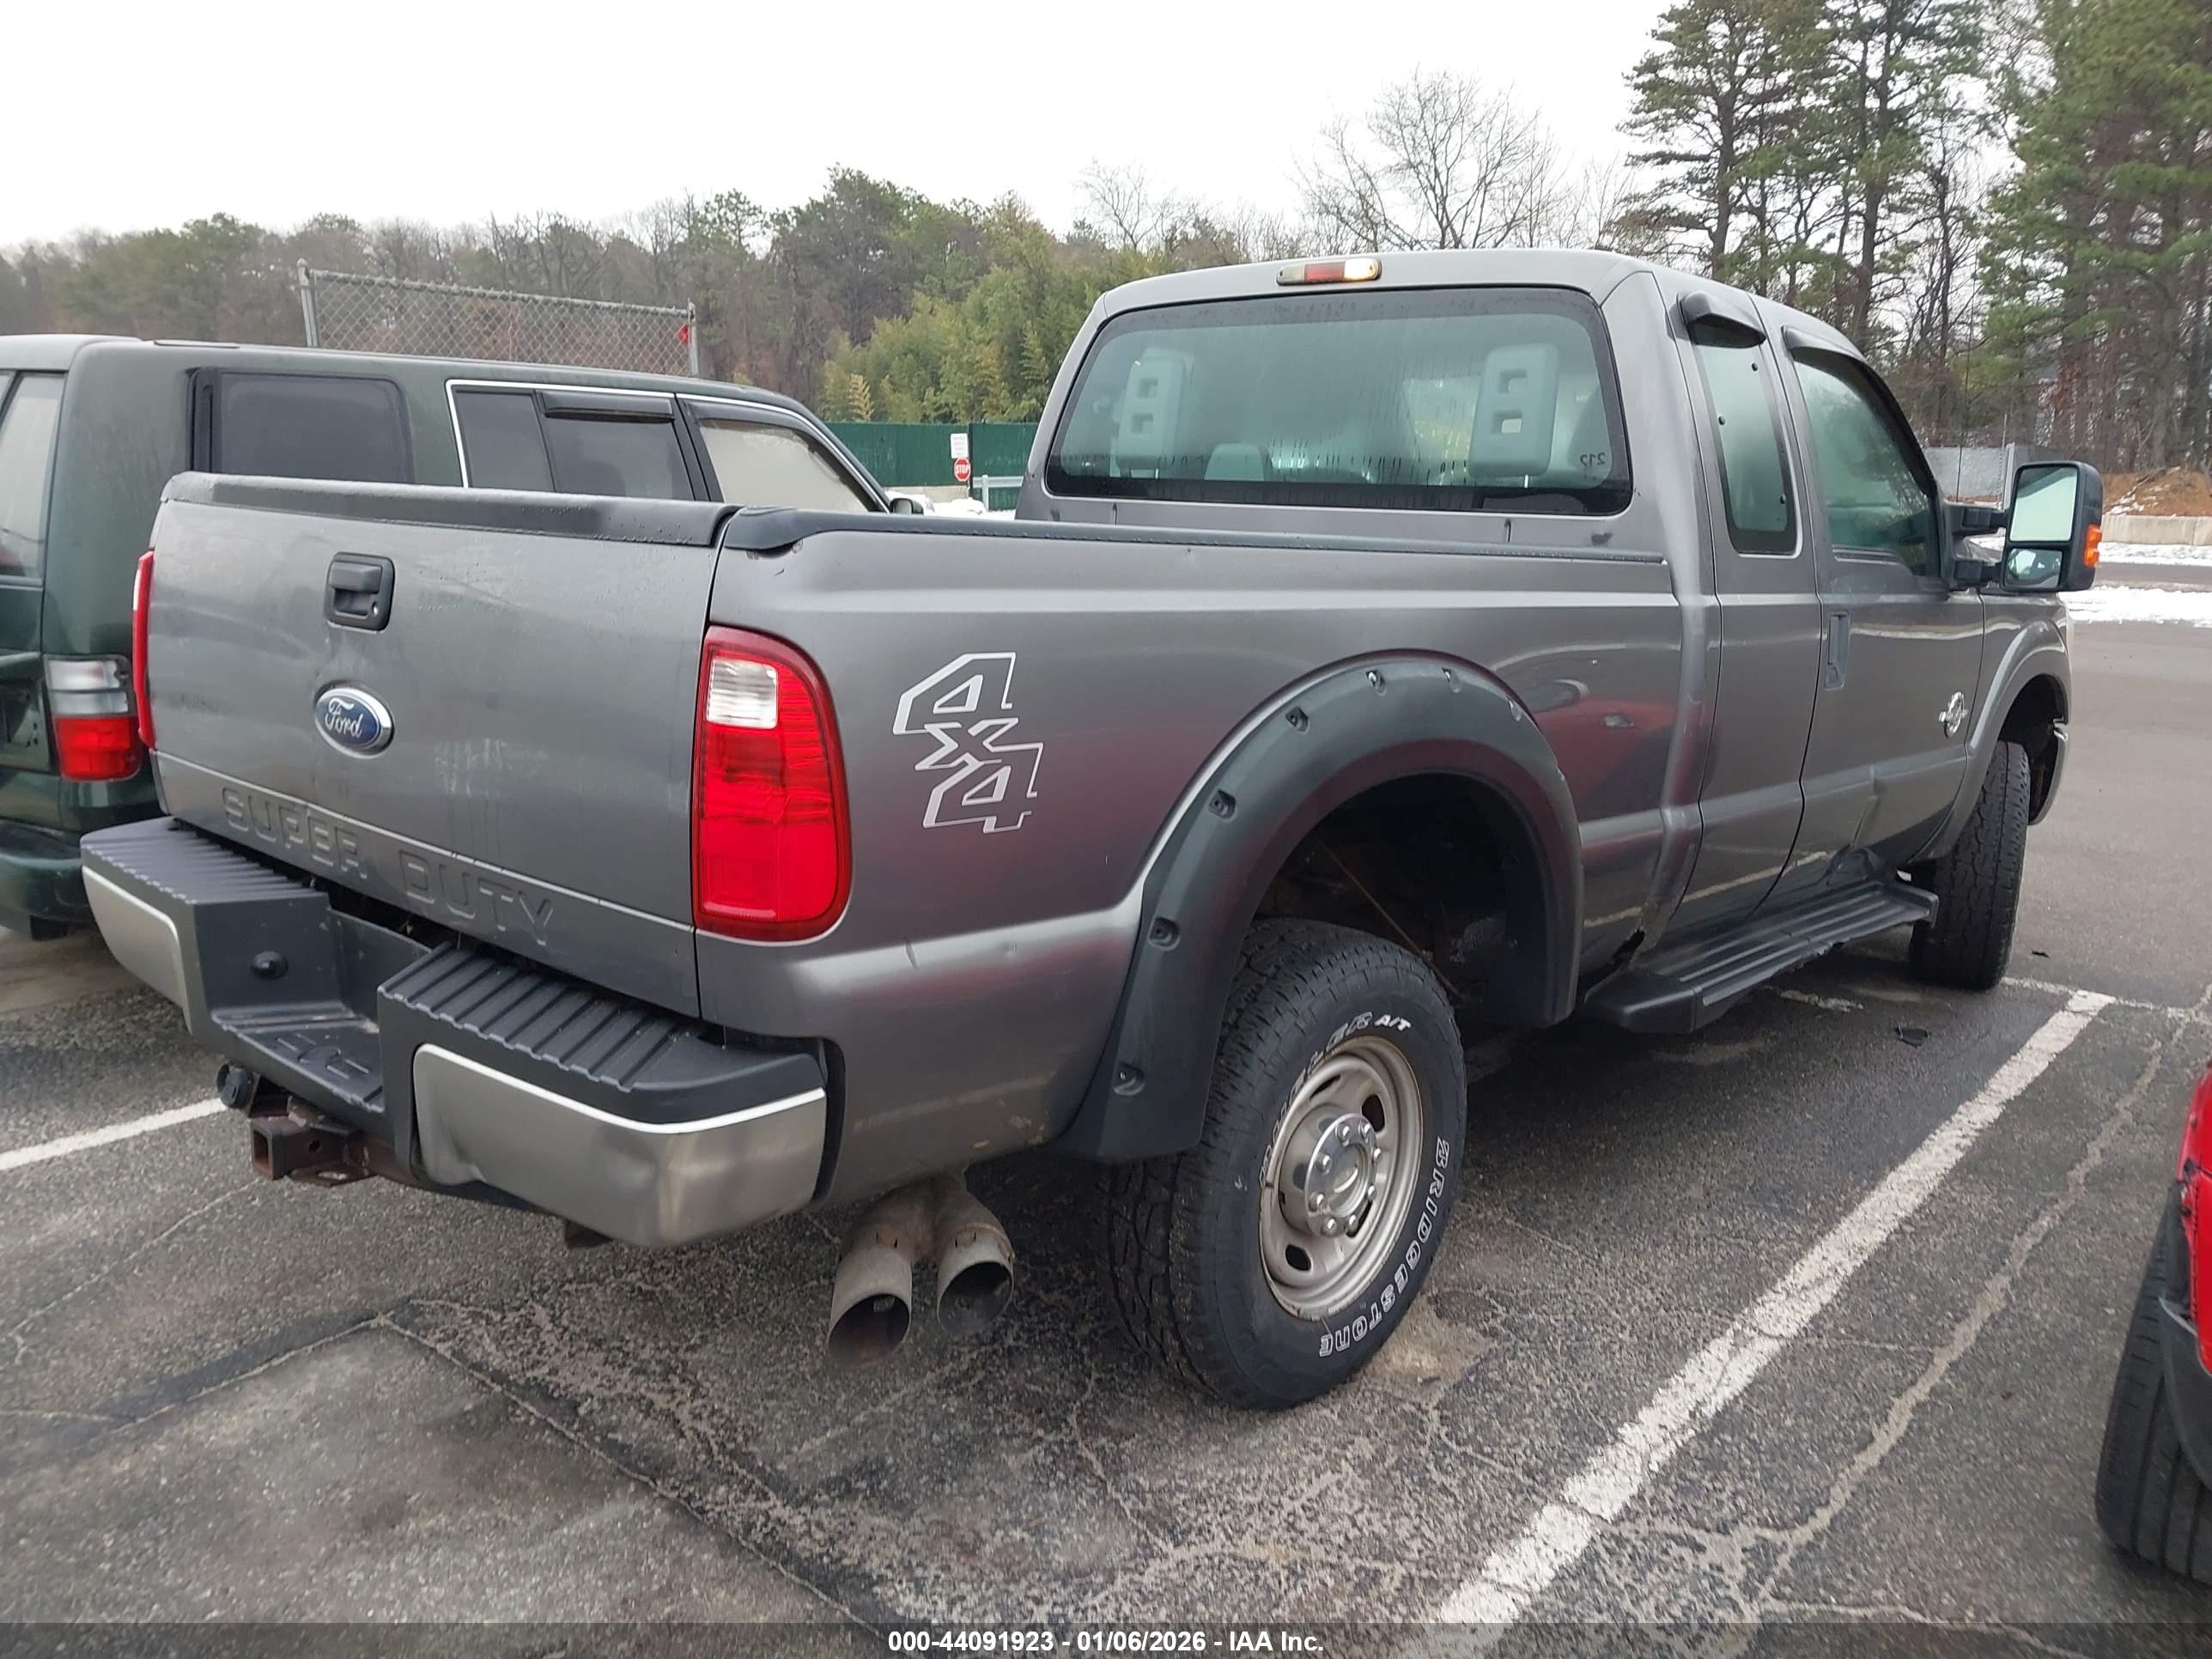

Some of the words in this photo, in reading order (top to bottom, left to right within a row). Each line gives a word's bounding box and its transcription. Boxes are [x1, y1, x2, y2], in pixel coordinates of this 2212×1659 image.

[955, 464, 969, 475] STOP
[325, 696, 364, 739] Ford
[222, 787, 368, 880] SUPER
[398, 849, 554, 945] DUTY
[1374, 1013, 1412, 1031] A/T
[1320, 1135, 1450, 1358] BRIDGESTONE
